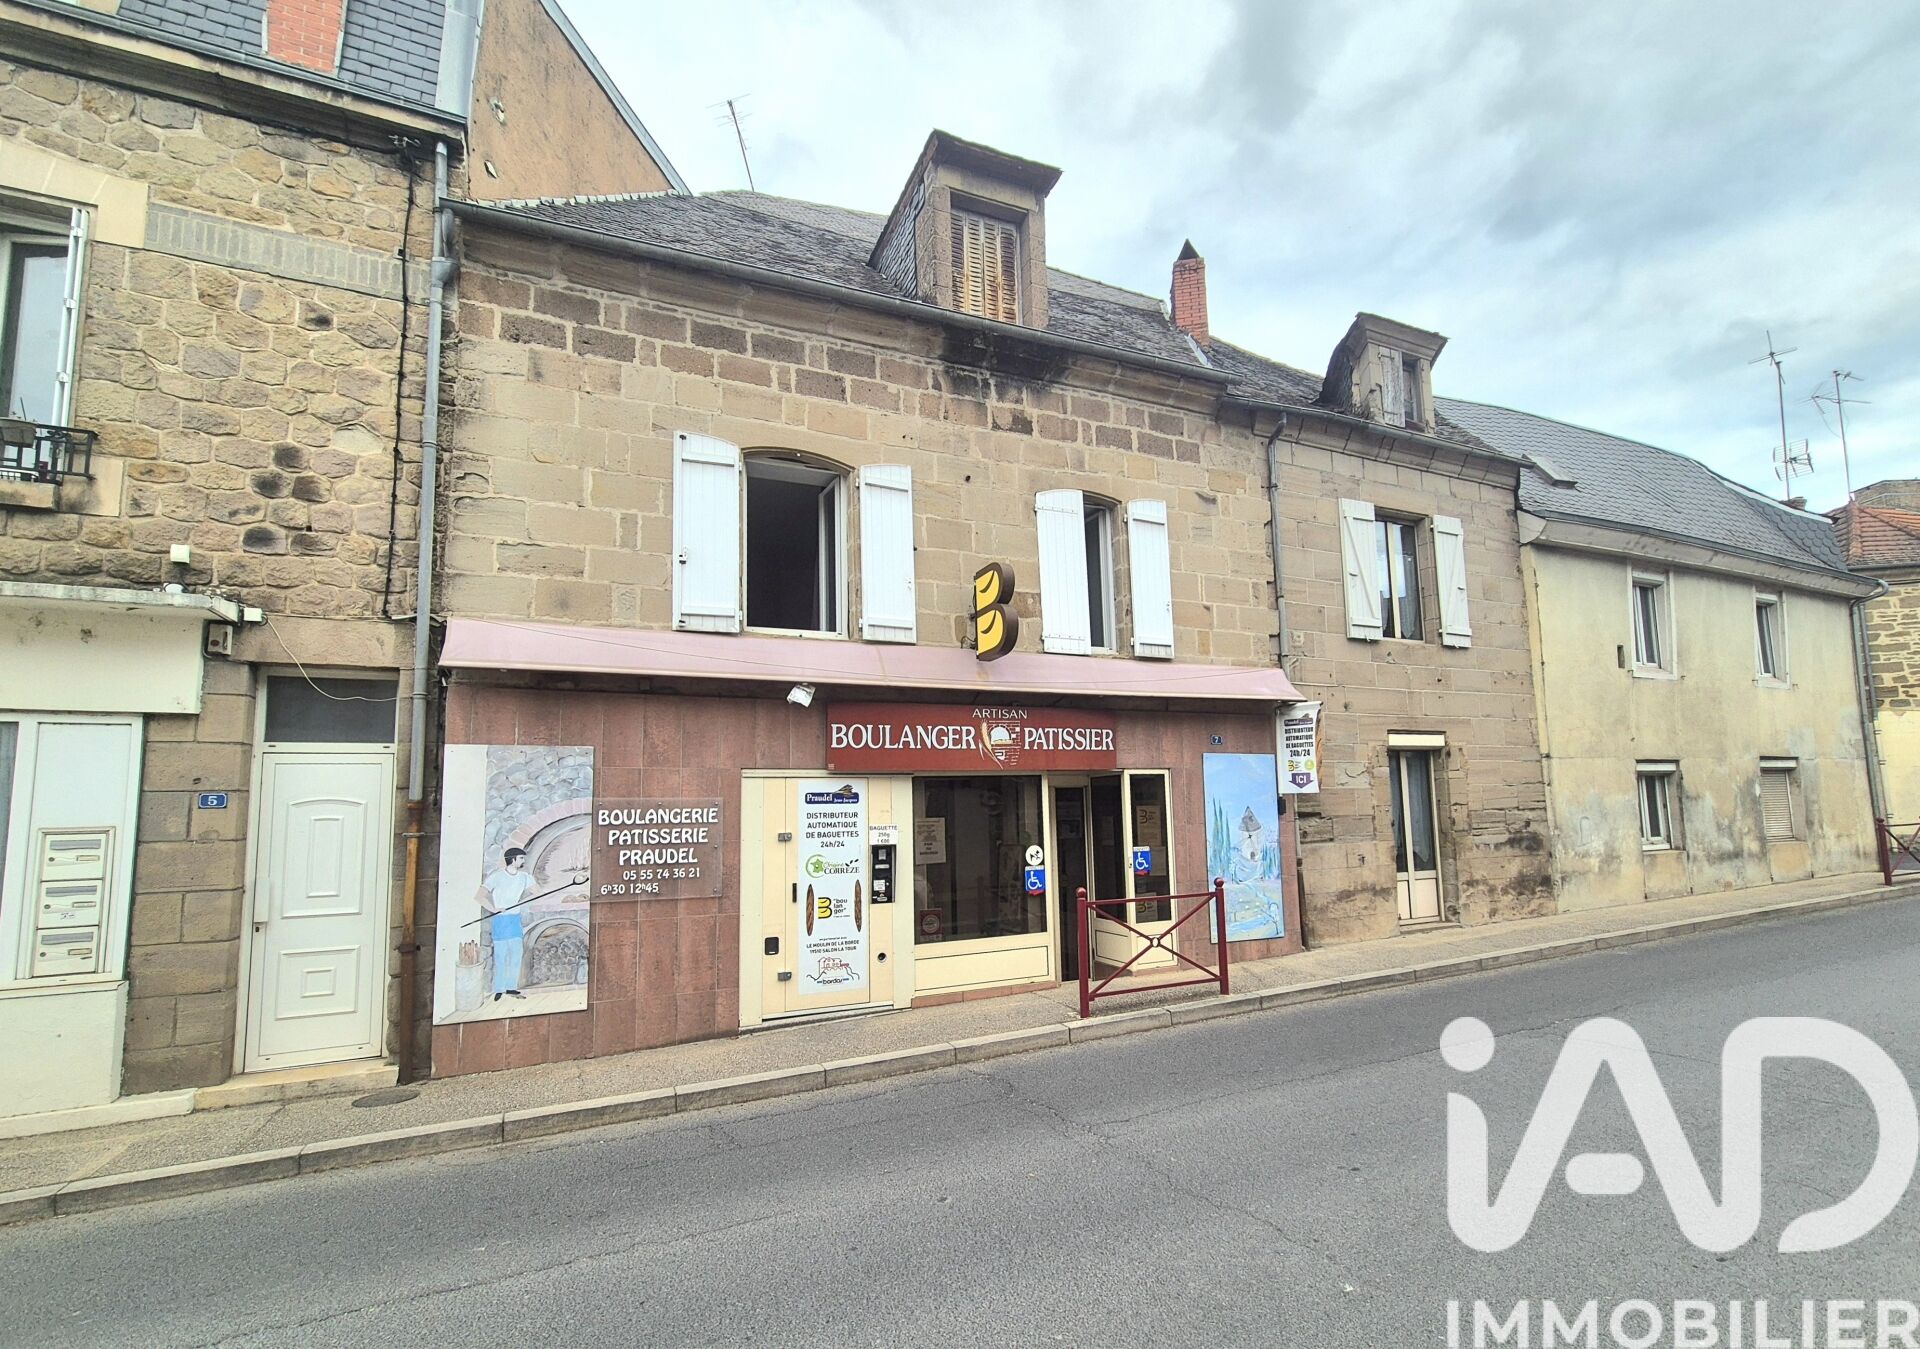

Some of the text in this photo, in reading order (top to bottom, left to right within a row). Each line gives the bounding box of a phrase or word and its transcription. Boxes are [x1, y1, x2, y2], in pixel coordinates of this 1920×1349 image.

[972, 708, 1028, 719] ARTISAN
[831, 724, 976, 749] BOULANGER
[1024, 727, 1114, 750] PATISSIER
[1290, 749, 1310, 757] 24h/24
[1296, 775, 1306, 784] ICI
[208, 796, 217, 805] 5
[806, 794, 833, 802] Praudel
[598, 808, 718, 825] BOULANGERIE
[807, 821, 858, 829] AUTOMATIQUE
[608, 828, 708, 845] PATISSERIE
[820, 840, 845, 848] 24h/24
[619, 848, 698, 866] PRAUDEL
[623, 867, 700, 880] 05 55 74 36 21
[600, 882, 659, 895] 6h30 12h45
